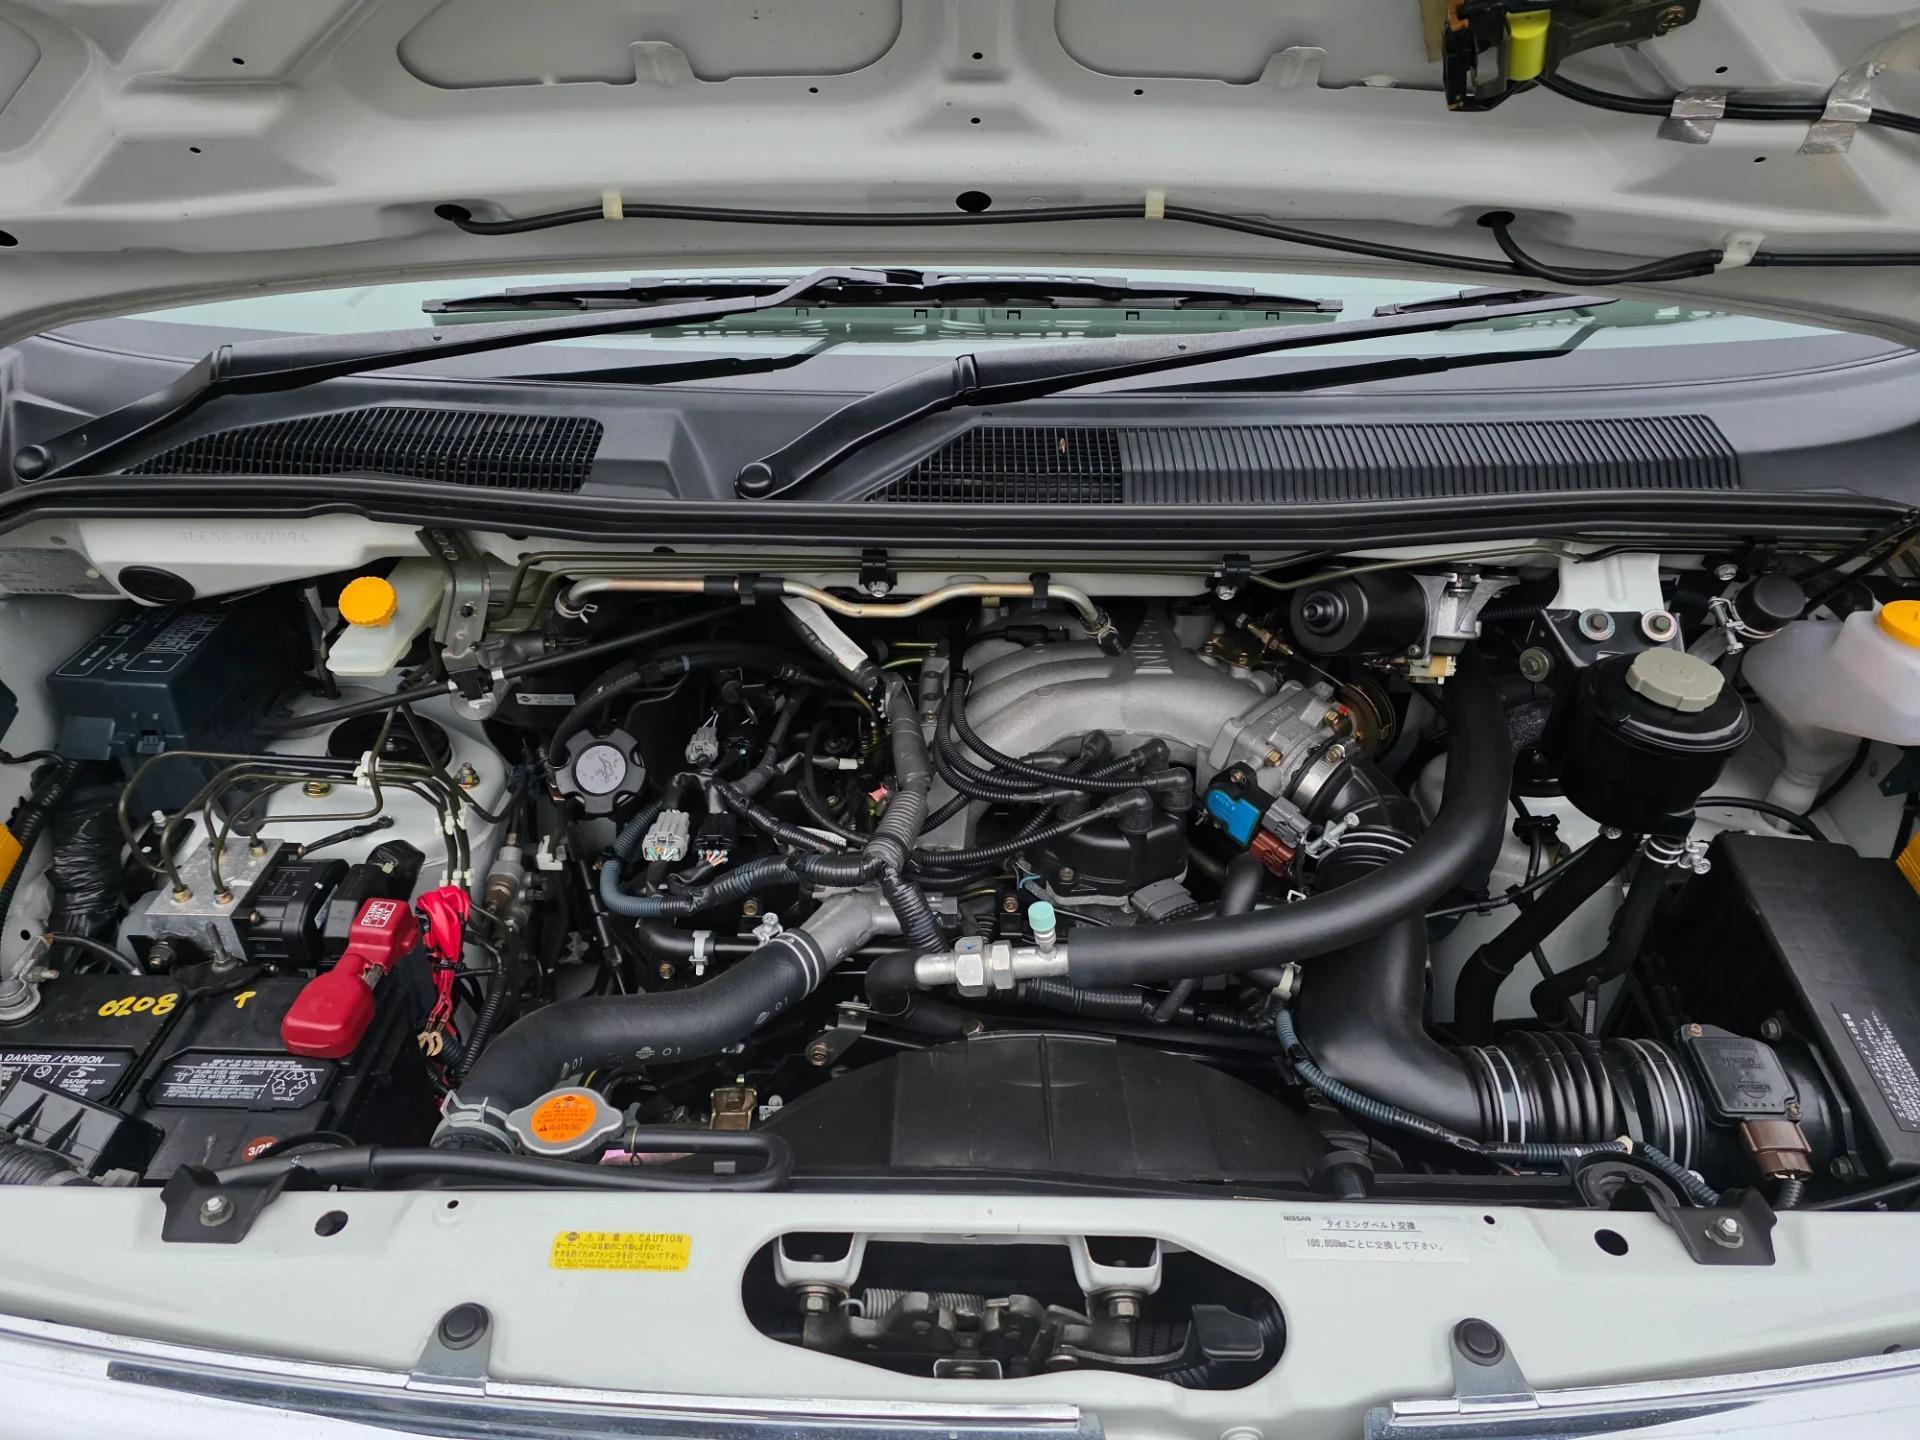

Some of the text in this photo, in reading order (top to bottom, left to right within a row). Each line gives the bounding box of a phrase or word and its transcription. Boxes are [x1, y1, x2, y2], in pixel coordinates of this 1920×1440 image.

[98, 992, 179, 1017] 0208
[4, 1053, 105, 1064] DANGER / POISON
[548, 1123, 582, 1132] WARNING
[1326, 1220, 1416, 1231] タイミングベルト交換
[638, 1234, 683, 1243] CAUTION
